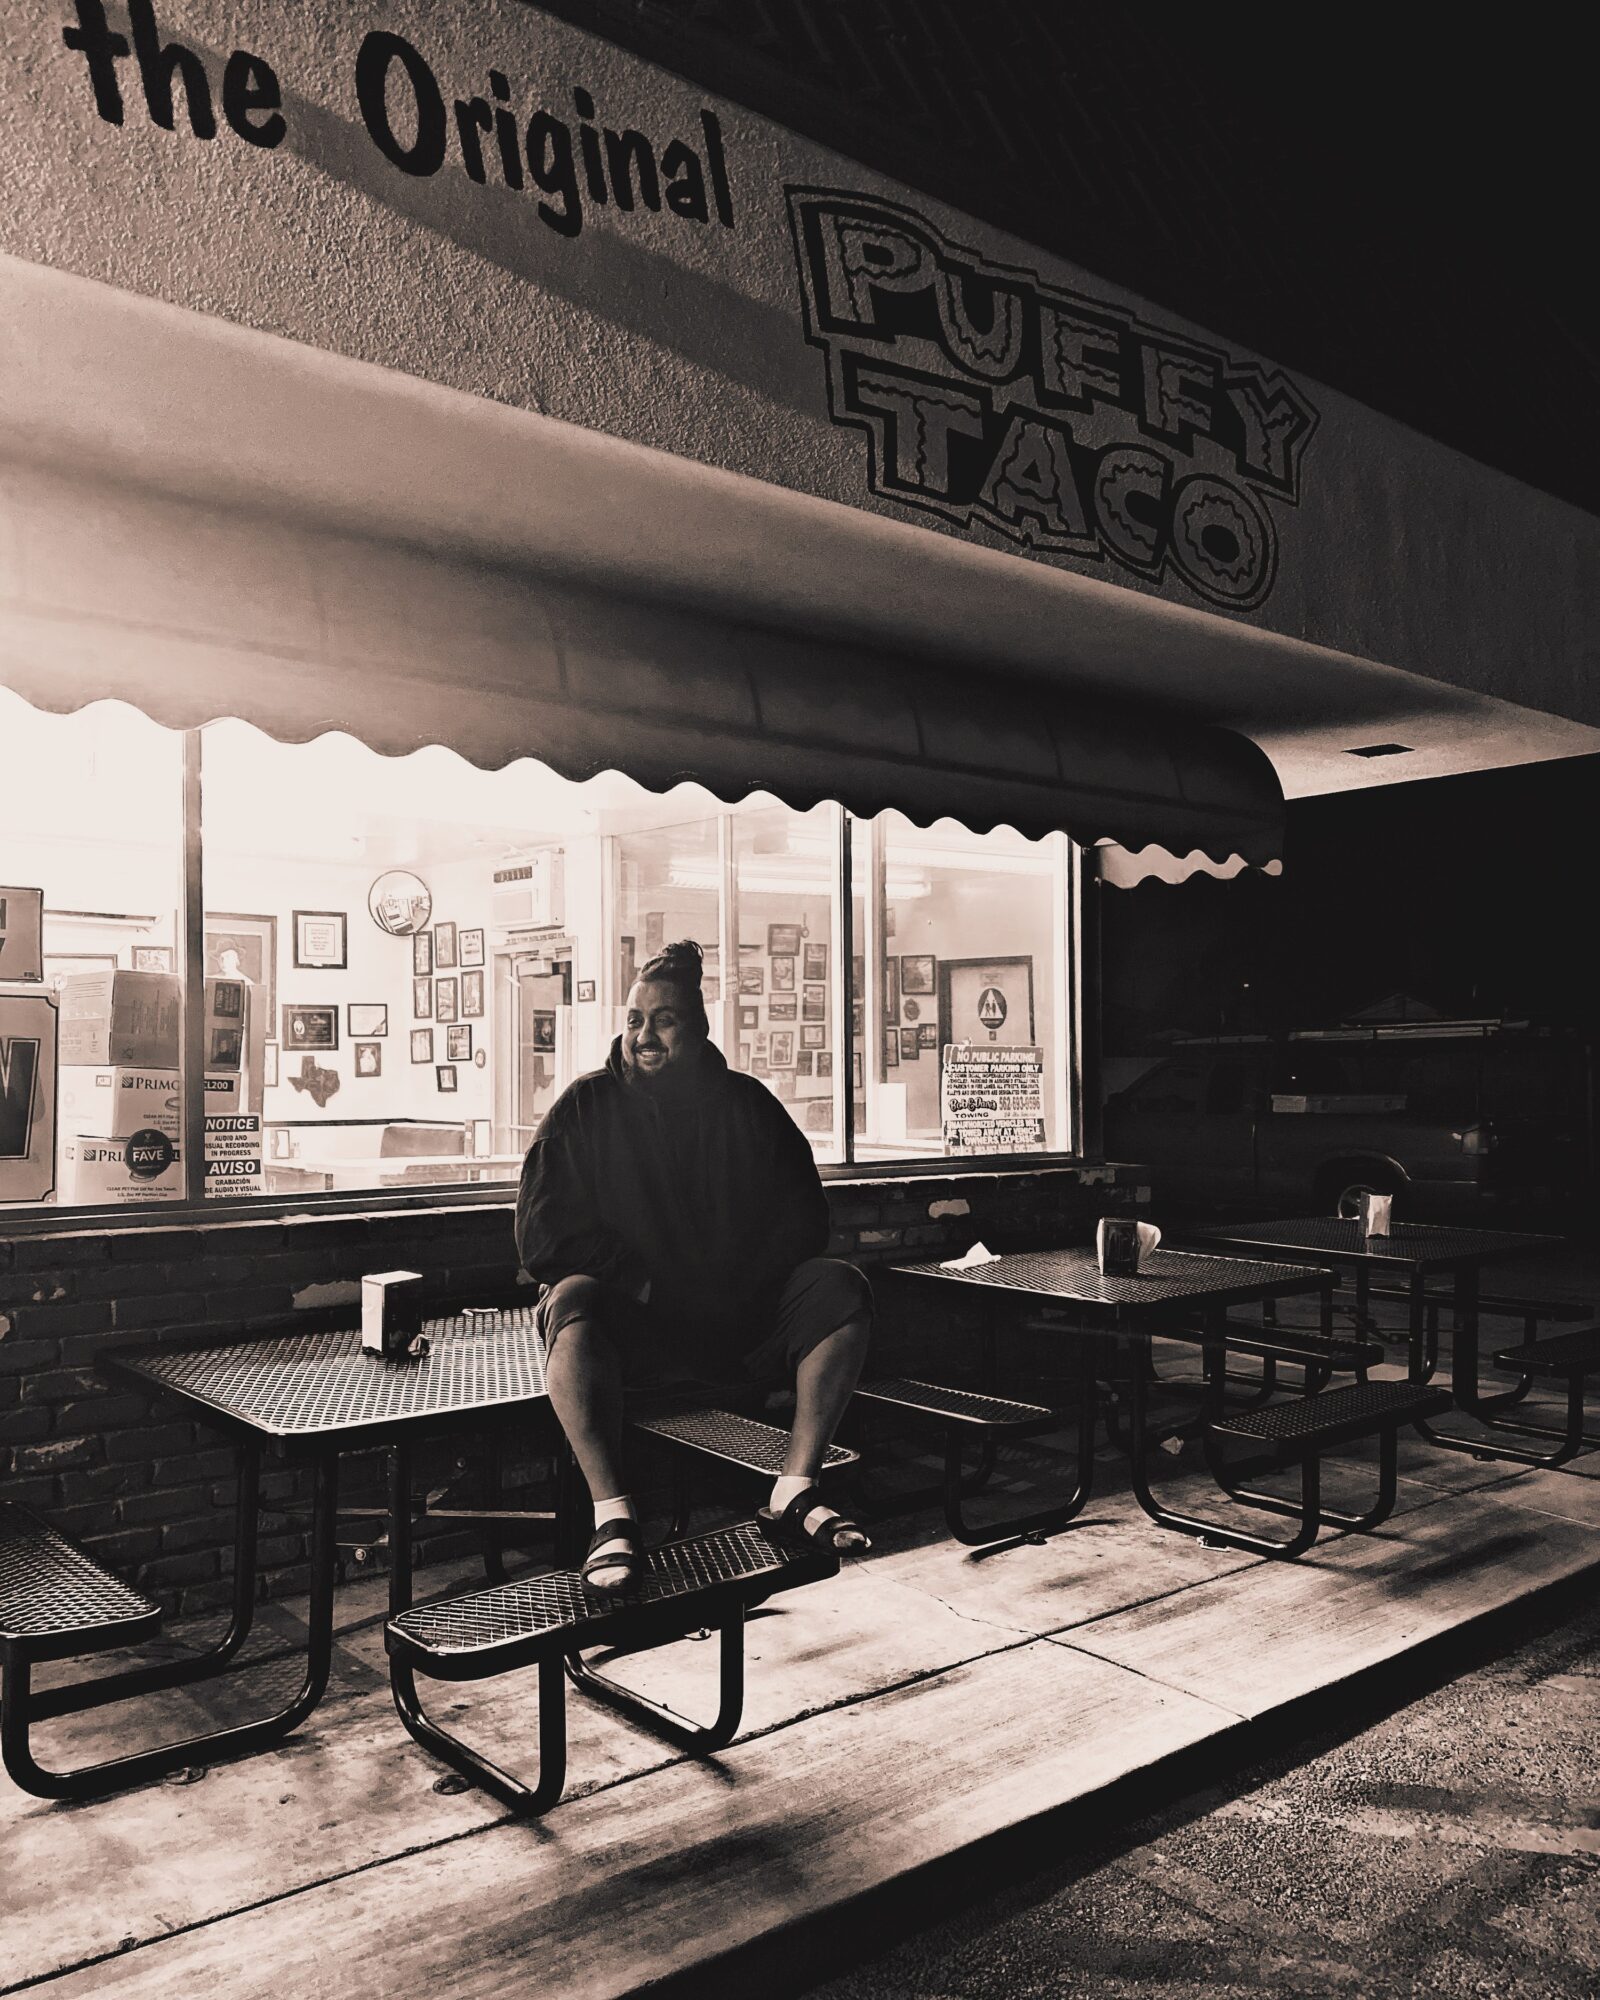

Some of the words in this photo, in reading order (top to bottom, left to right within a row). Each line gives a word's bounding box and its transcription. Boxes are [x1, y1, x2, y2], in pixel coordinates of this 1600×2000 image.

[63, 0, 288, 149] the
[355, 30, 735, 238] Original
[800, 198, 1310, 497] PUFFY
[838, 346, 1272, 602] TACO
[956, 1051, 969, 1063] NO
[971, 1052, 1000, 1063] PUBLIC
[951, 1064, 989, 1072] CUSTOMER
[990, 1064, 1020, 1072] PARKING
[205, 1118, 255, 1130] NOTICE
[983, 1128, 1002, 1136] AWAY
[1003, 1127, 1012, 1136] AT
[99, 1149, 124, 1162] PRI
[132, 1150, 165, 1162] FAVE
[209, 1161, 256, 1175] AVISO
